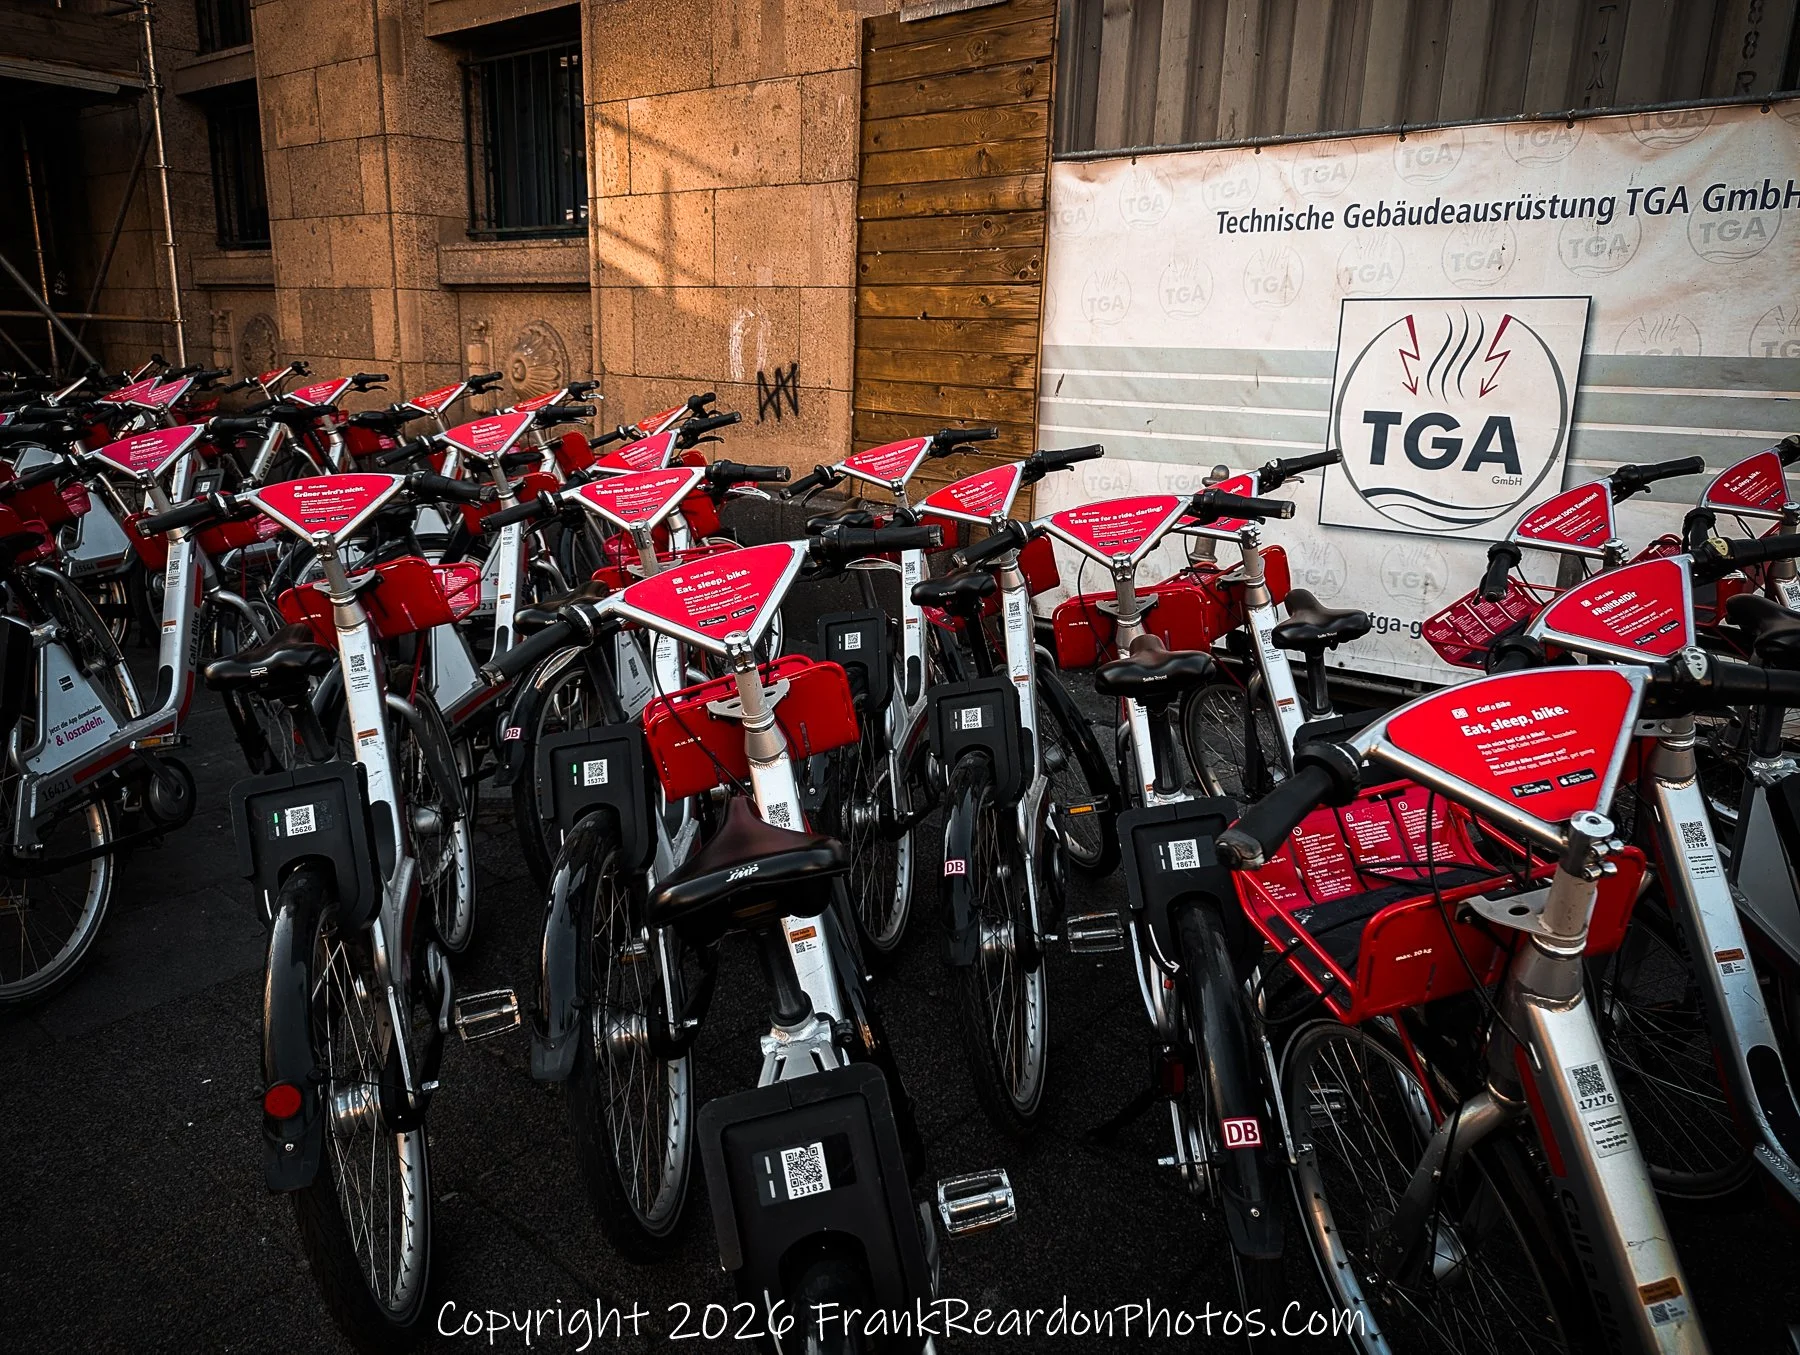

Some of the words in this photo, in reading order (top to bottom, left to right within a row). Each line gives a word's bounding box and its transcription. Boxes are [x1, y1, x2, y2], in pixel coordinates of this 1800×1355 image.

[1514, 122, 1574, 150] TGA
[1403, 142, 1454, 168] TGA
[1300, 161, 1347, 185] TGA
[1208, 177, 1250, 200] TGA
[1124, 194, 1165, 214] TGA
[1217, 205, 1335, 235] Technische
[1343, 193, 1617, 229] Gebäudeausrüstung
[1626, 185, 1690, 216] TGA
[1702, 178, 1800, 212] GmbH
[1700, 216, 1767, 244] TGA
[1568, 232, 1630, 260] TGA
[1451, 249, 1504, 273] TGA
[1347, 262, 1394, 284] TGA
[1250, 272, 1295, 295] TGA
[1087, 295, 1124, 314] TGA
[1164, 285, 1206, 306] TGA
[1761, 340, 1800, 358] TG
[1363, 411, 1522, 475] TGA
[321, 487, 344, 496] wird's
[344, 486, 366, 494] nicht.
[639, 483, 655, 491] ride,
[655, 476, 680, 488] darling!
[1088, 474, 1127, 491] TGA
[1491, 475, 1523, 487] GmbH
[1574, 491, 1599, 509] Emotion!
[1069, 517, 1087, 526] Take
[1100, 514, 1112, 523] for
[1118, 511, 1136, 520] ride,
[1136, 504, 1164, 517] darling!
[675, 585, 697, 595] Eat,
[696, 577, 726, 590] sleep,
[726, 569, 751, 581] bike.
[1292, 568, 1337, 586] TGA
[1387, 570, 1440, 590] TGA
[188, 646, 196, 666] Call
[192, 611, 200, 636] Bike
[60, 720, 69, 728] die
[69, 717, 78, 726] App
[78, 704, 103, 720] downloaden
[1476, 704, 1490, 714] Call
[1495, 701, 1512, 709] Bike
[1461, 719, 1492, 737] Eat,
[1491, 712, 1534, 733] sleep,
[1531, 704, 1569, 721] bike.
[56, 735, 65, 747] &
[64, 716, 106, 743] losradeln.
[503, 729, 518, 738] DB
[587, 777, 606, 785] 15370
[1569, 776, 1580, 785] App
[1579, 773, 1595, 782] Store
[41, 779, 72, 802] 16421
[1524, 785, 1541, 794] Google
[290, 825, 313, 835] 15626
[726, 863, 759, 883] SMP
[946, 861, 964, 874] DB
[1176, 860, 1198, 869] 18671
[1395, 953, 1413, 962] max.
[1579, 1093, 1615, 1110] 17176
[1226, 1122, 1258, 1144] DB
[793, 1182, 825, 1197] 23183
